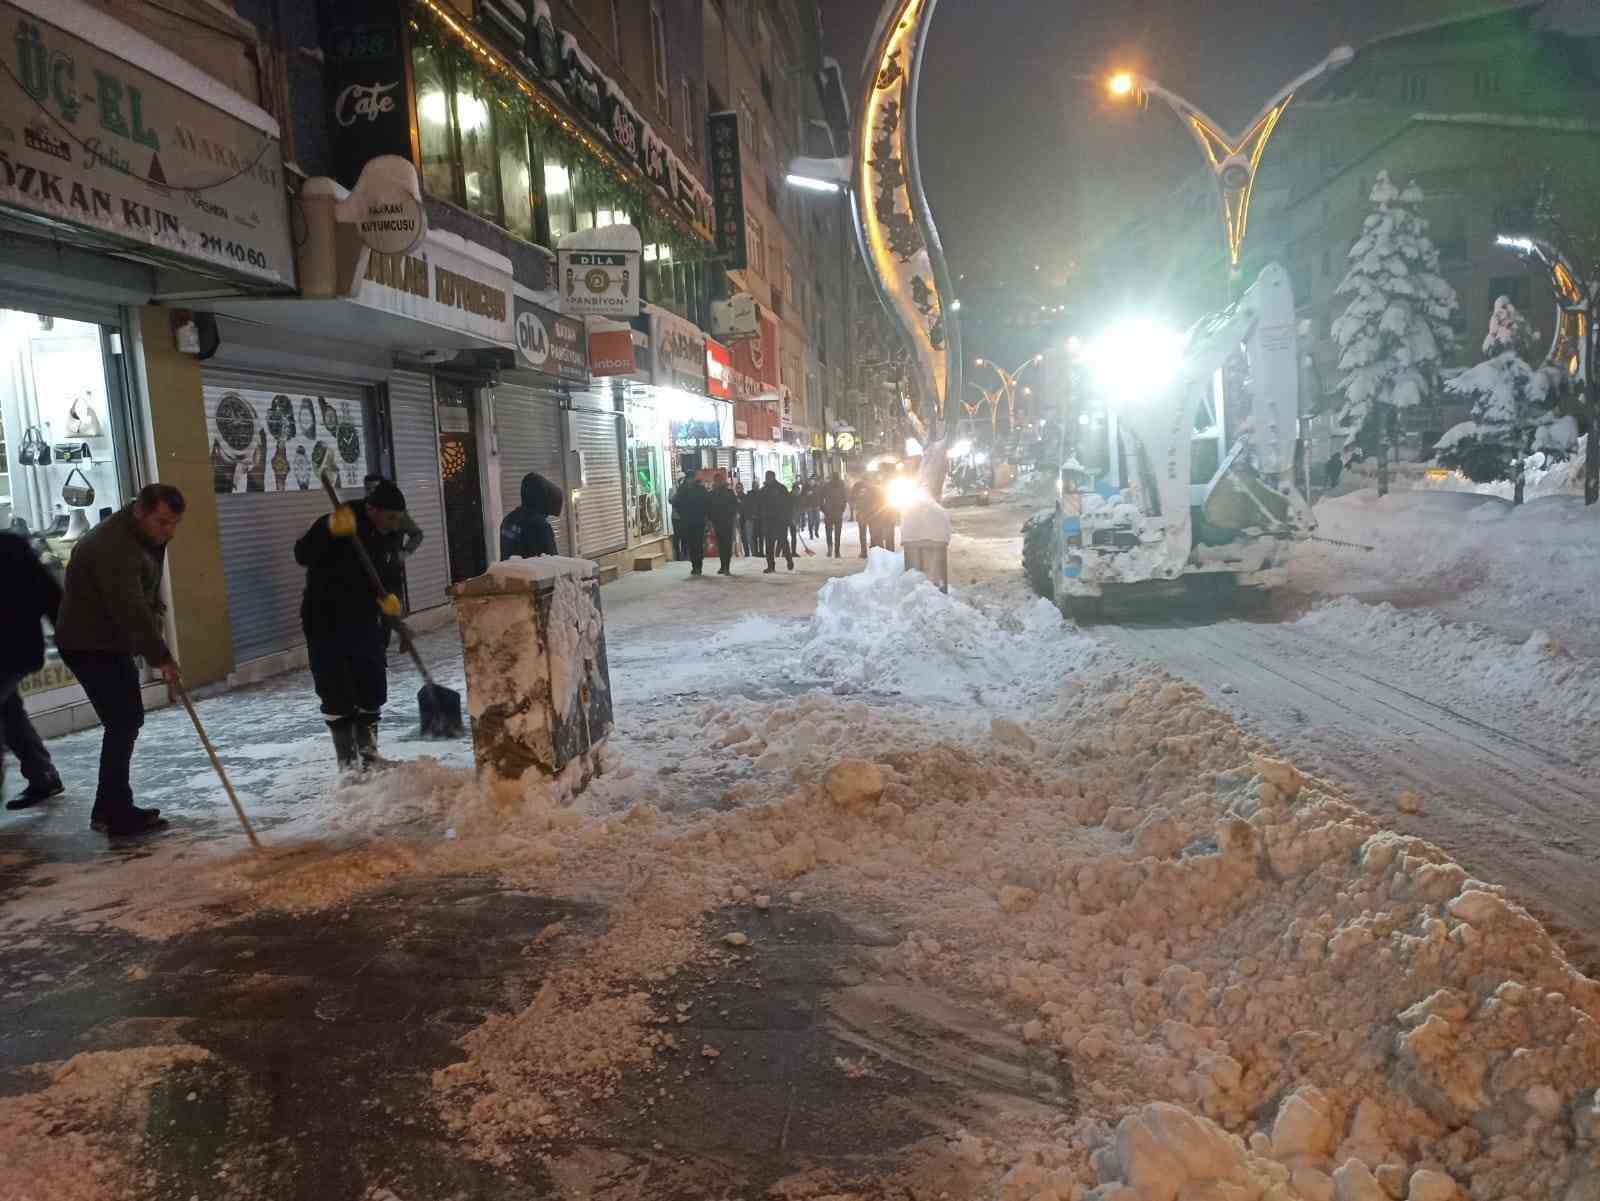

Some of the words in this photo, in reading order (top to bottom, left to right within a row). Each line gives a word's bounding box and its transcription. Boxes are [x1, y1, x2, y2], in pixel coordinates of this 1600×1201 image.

[335, 81, 399, 127] Cafe
[580, 255, 614, 265] DİLA
[519, 314, 546, 356] DİLA
